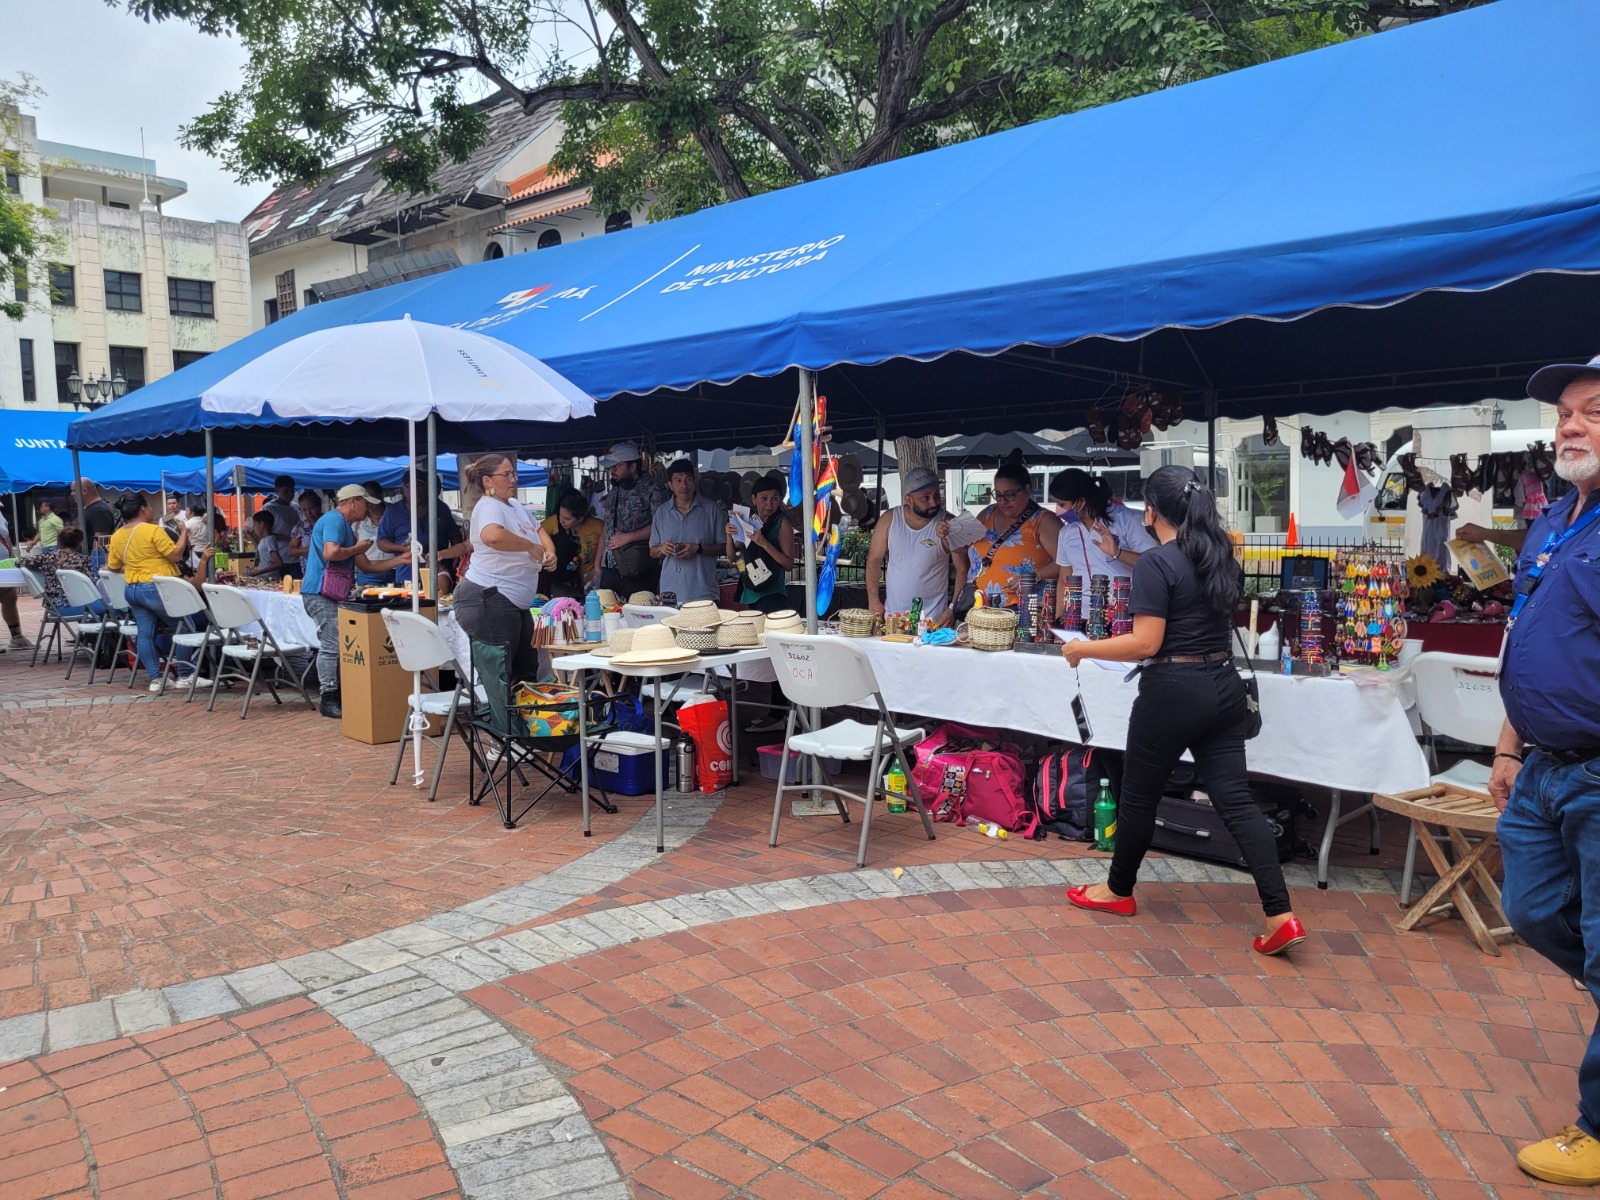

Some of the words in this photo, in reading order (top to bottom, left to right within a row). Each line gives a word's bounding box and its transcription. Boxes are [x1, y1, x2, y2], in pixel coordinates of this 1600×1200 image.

[685, 234, 846, 277] MINISTERIO
[659, 278, 704, 294] DE
[703, 250, 828, 287] CULTURA
[457, 349, 488, 378] LIMITLESS
[787, 652, 811, 662] 32602
[792, 667, 813, 680] OCA
[1459, 682, 1492, 692] 32623
